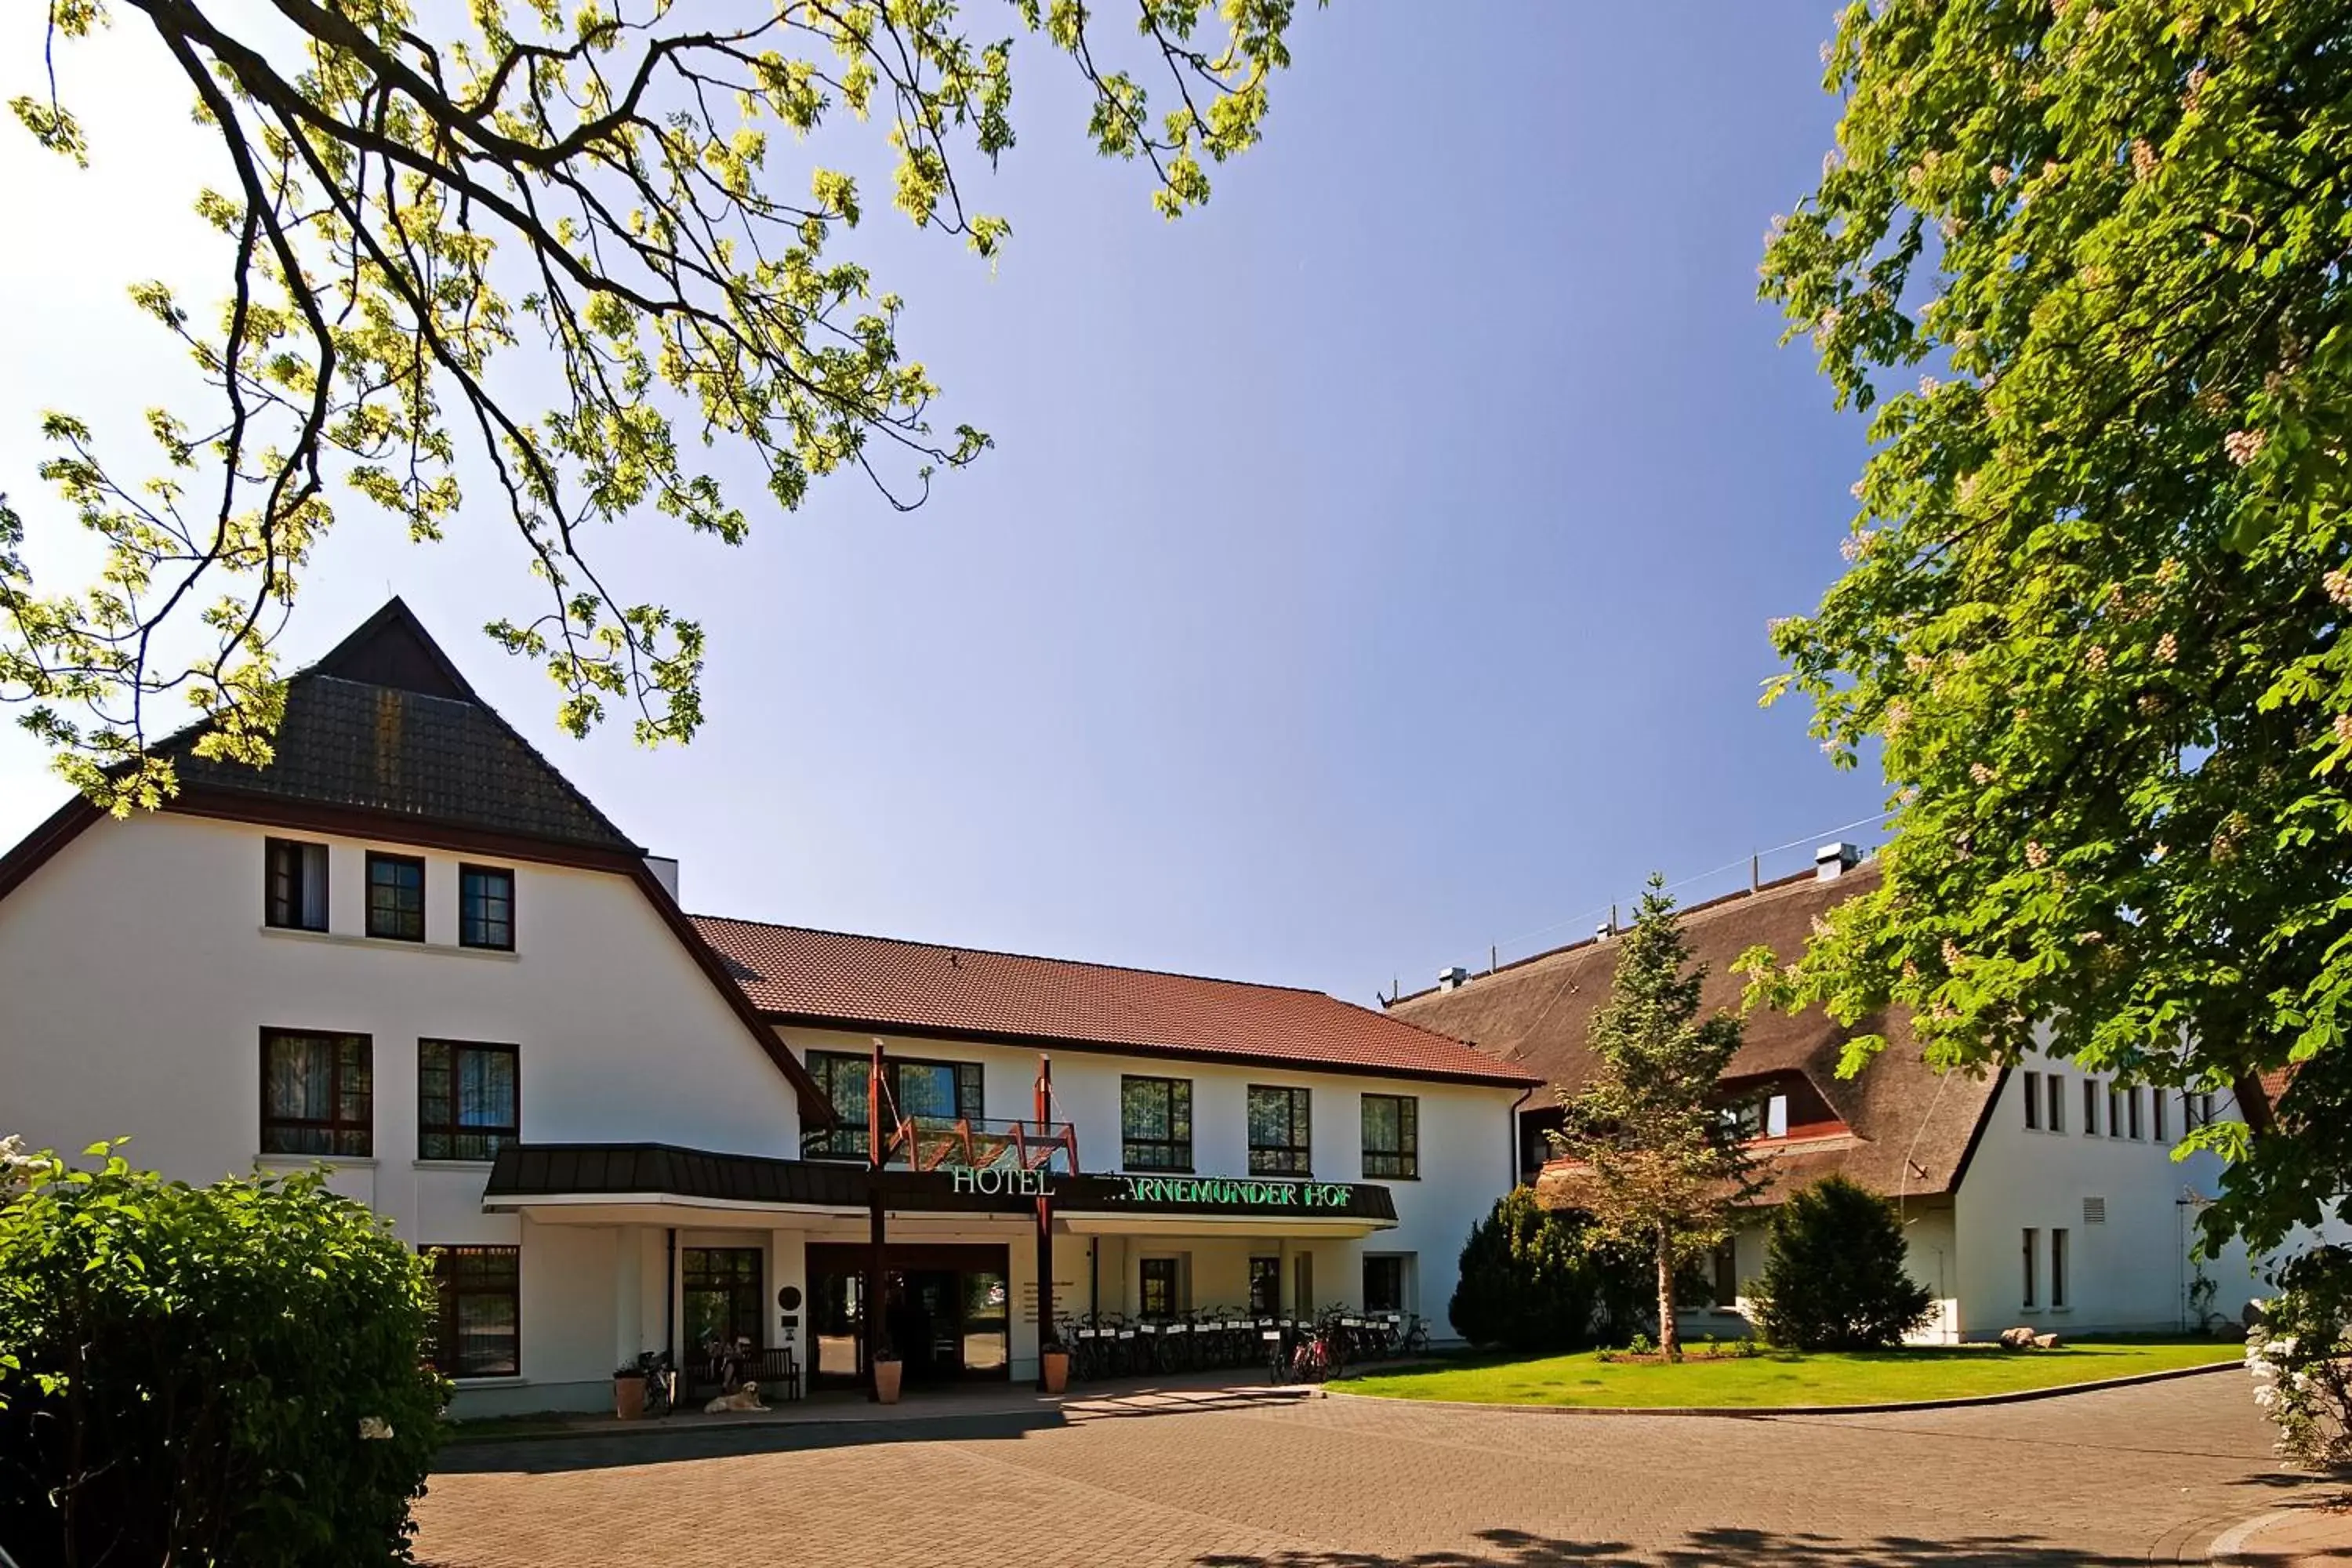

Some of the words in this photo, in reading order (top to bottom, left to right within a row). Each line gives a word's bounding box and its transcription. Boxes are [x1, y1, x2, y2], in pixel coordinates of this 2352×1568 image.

[952, 1167, 1056, 1196] HOTEL
[1095, 1175, 1298, 1205] ARNEMÜNDER
[1304, 1181, 1354, 1207] HOF
